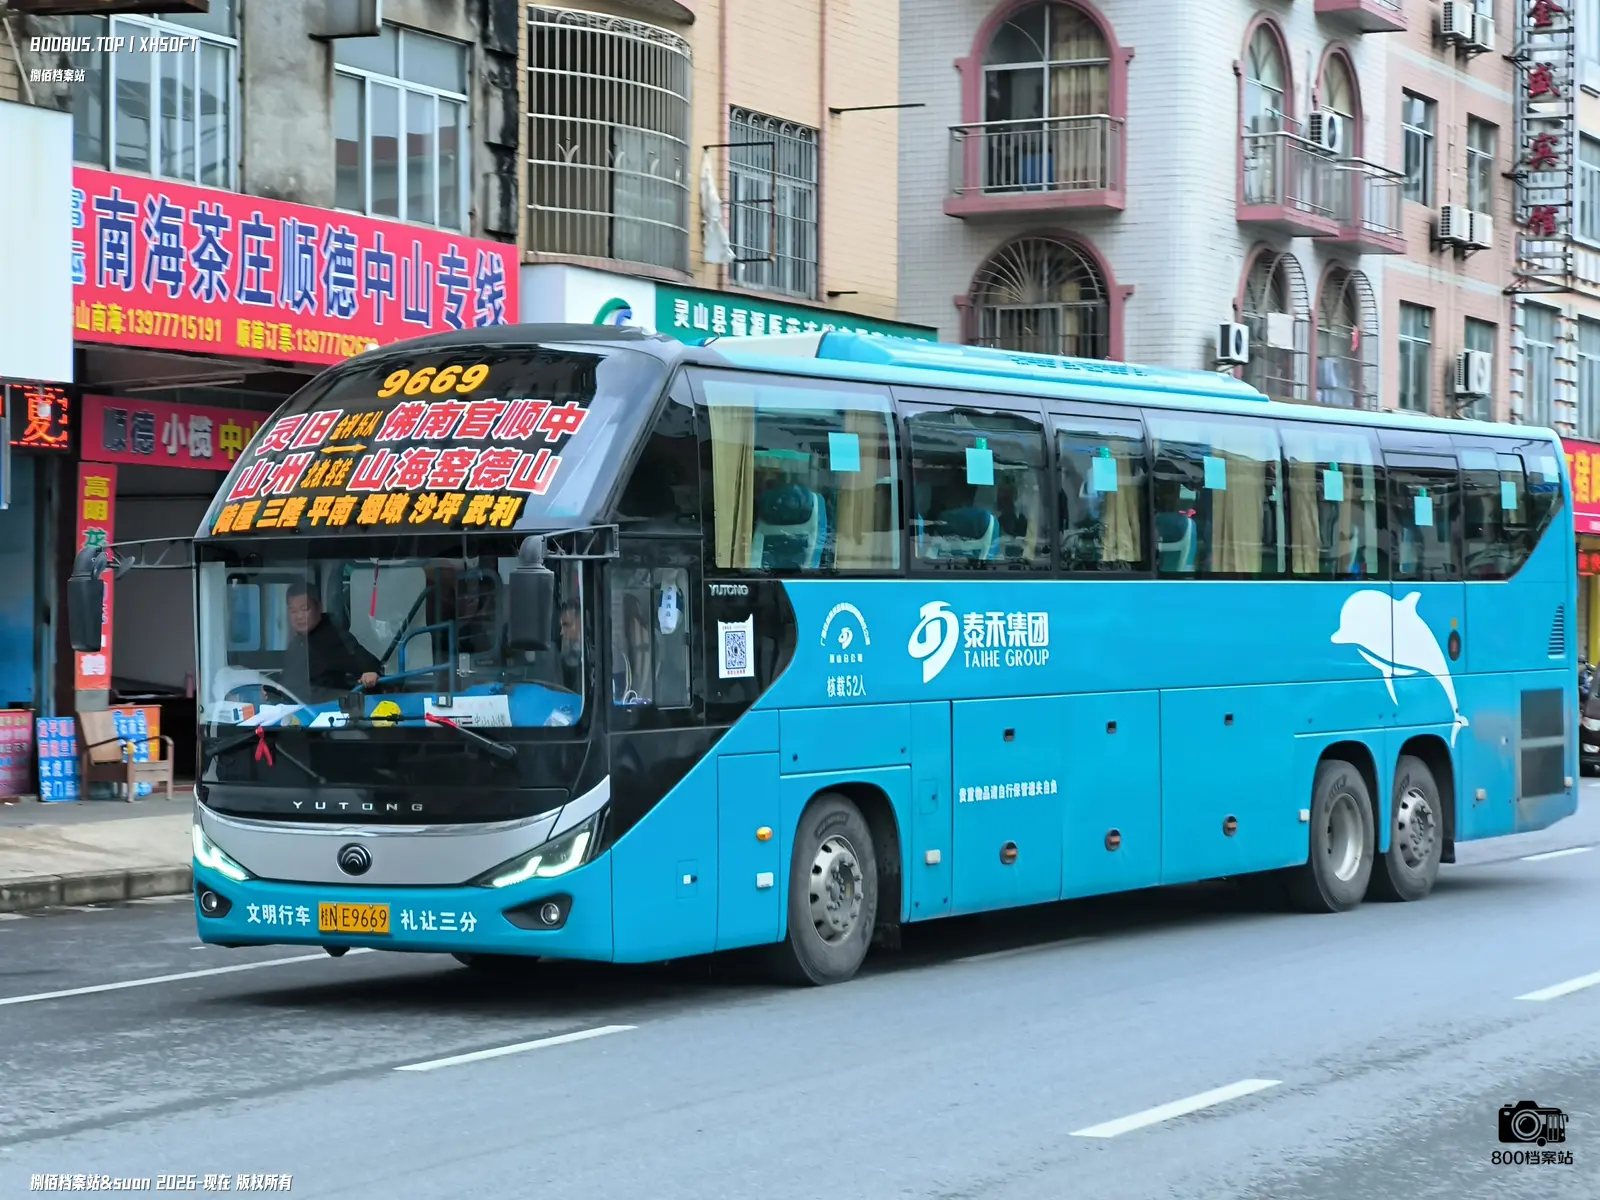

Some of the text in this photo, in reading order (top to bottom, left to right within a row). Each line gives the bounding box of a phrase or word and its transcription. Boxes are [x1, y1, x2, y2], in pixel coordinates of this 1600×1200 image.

[92, 186, 507, 328] 南海茶庄顺德中山专线
[73, 300, 221, 343] 山南海:13977715191
[377, 364, 489, 398] 9669
[307, 495, 357, 527] 平南
[408, 492, 459, 524] 沙坪
[461, 495, 522, 527] 武利
[709, 584, 749, 596] YUTONG
[963, 611, 1050, 648] 泰禾集团
[963, 649, 1050, 669] TAIHE GROUP
[827, 675, 866, 697] 核载52人
[292, 800, 425, 812] YUTONG
[246, 903, 311, 926] 文明行车
[400, 909, 478, 934] 礼让三分
